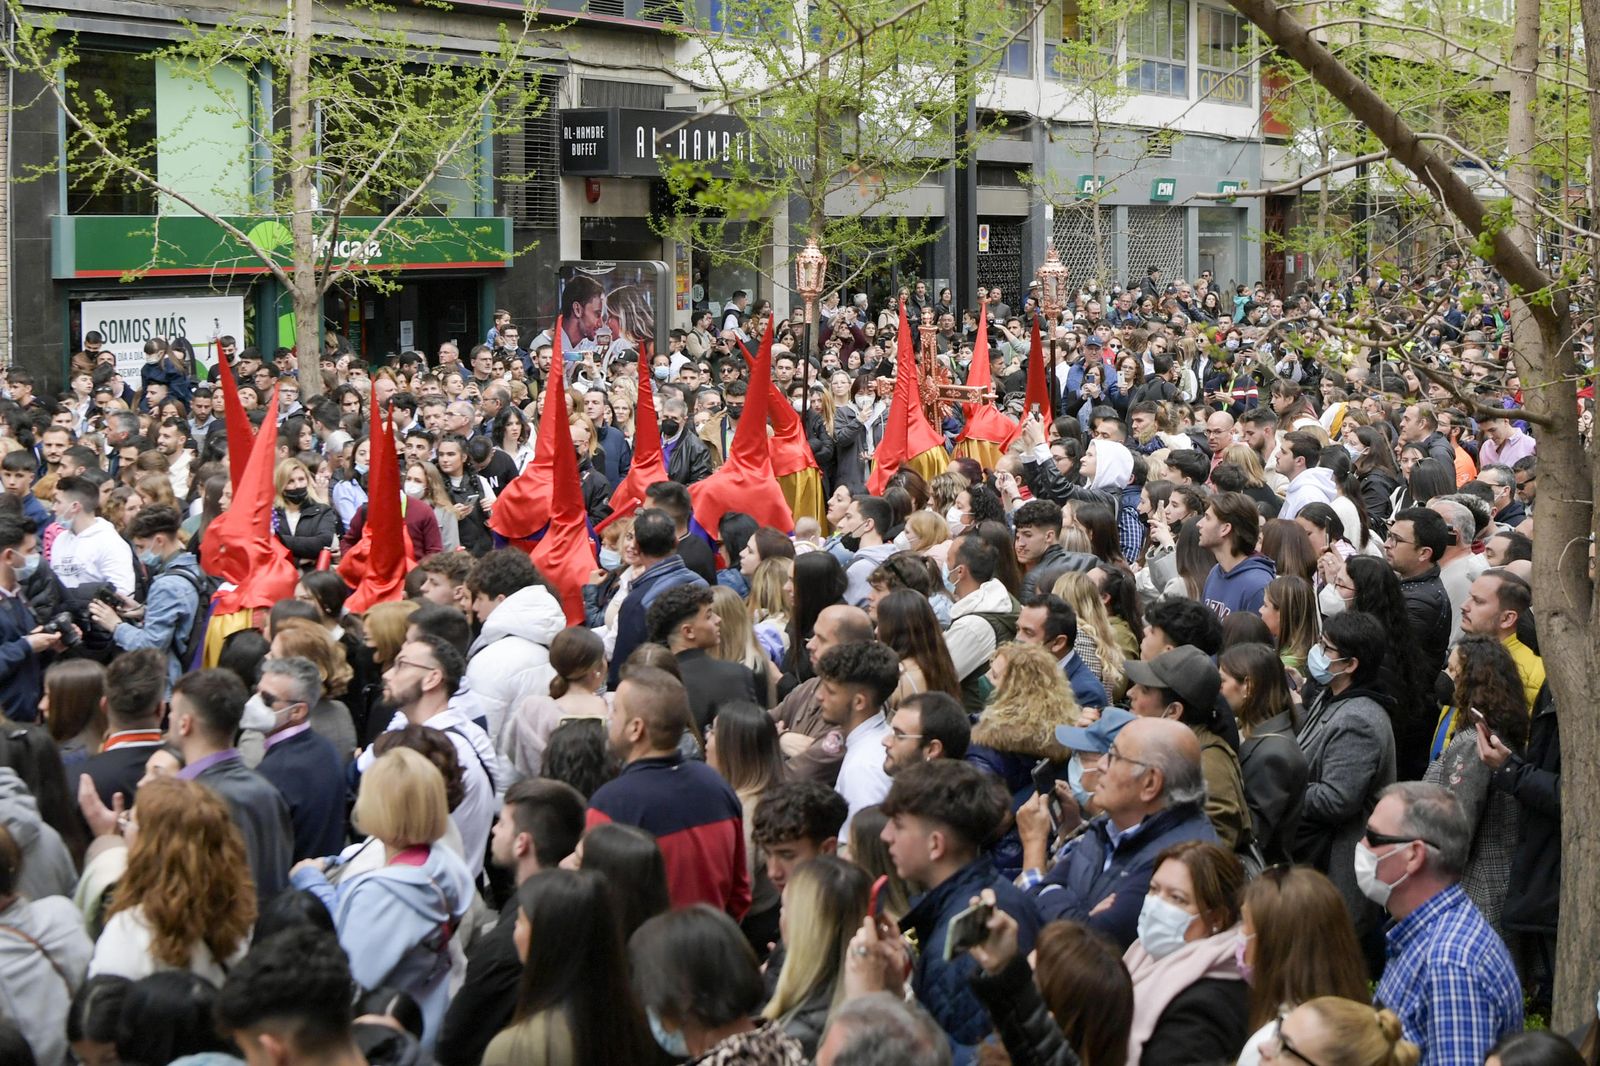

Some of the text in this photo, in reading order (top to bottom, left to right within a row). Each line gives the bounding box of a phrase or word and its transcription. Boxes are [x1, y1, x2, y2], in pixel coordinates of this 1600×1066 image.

[563, 125, 605, 140] AL-HAMBRE
[571, 142, 597, 156] BUFFET
[99, 312, 186, 344] SOMOS MÁS
